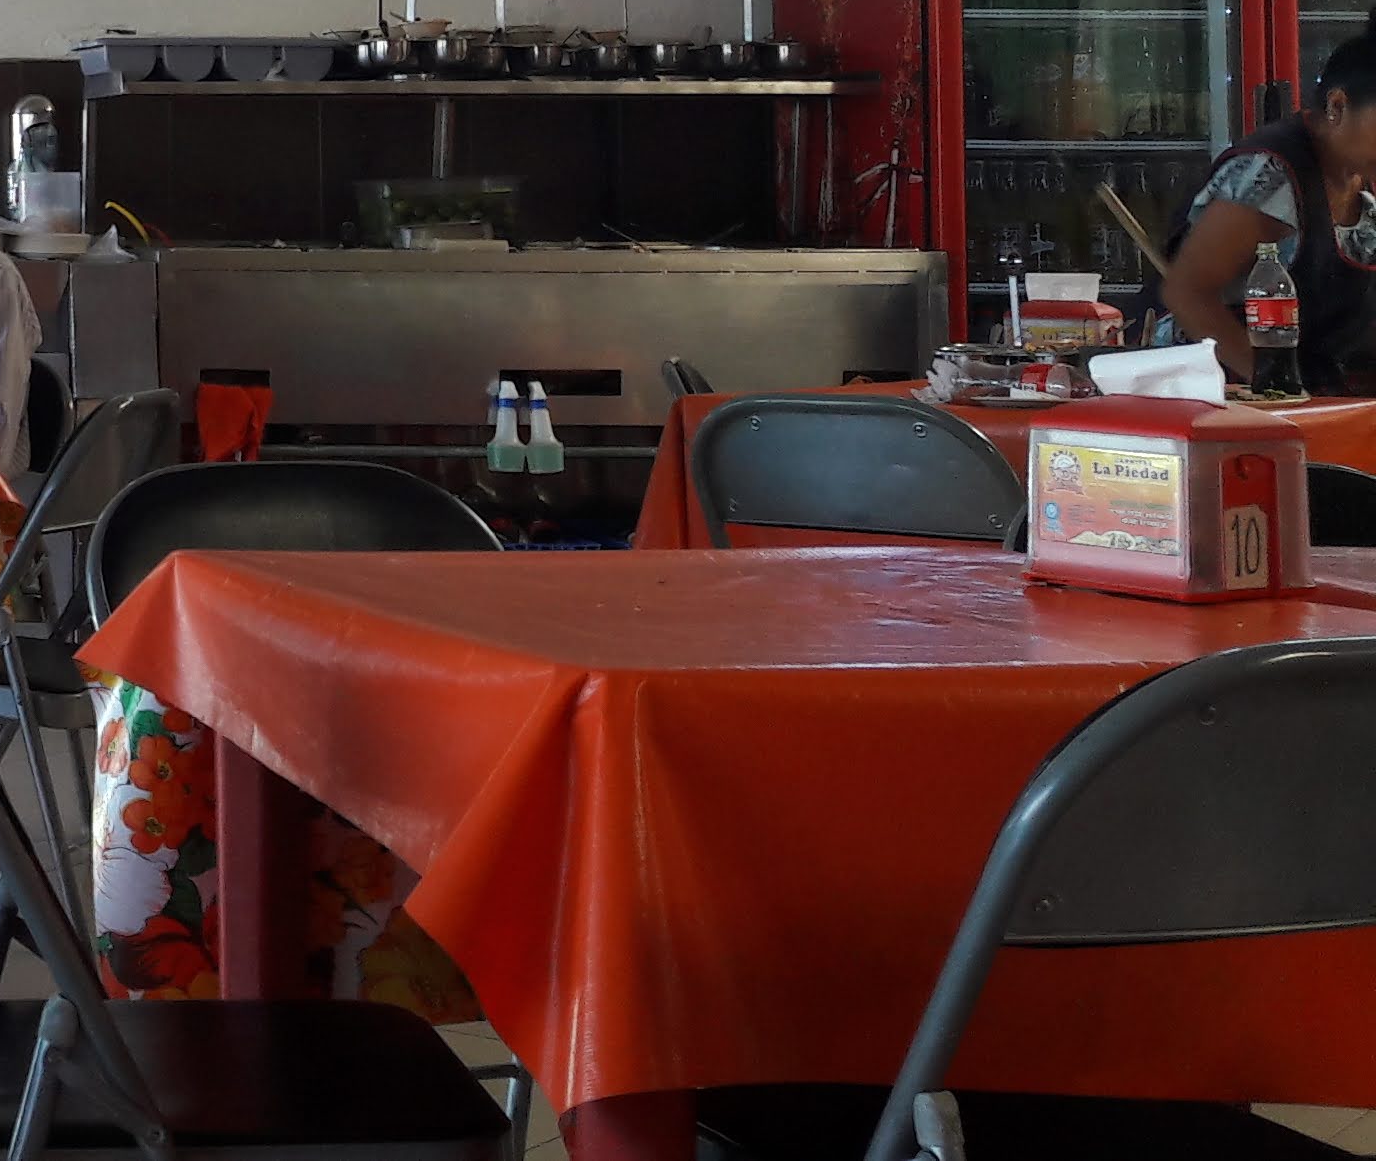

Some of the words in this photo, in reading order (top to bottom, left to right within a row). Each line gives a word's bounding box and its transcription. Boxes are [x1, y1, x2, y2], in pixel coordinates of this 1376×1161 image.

[1091, 461, 1111, 476] La
[1114, 463, 1170, 481] Piedad
[1231, 516, 1259, 577] 10
